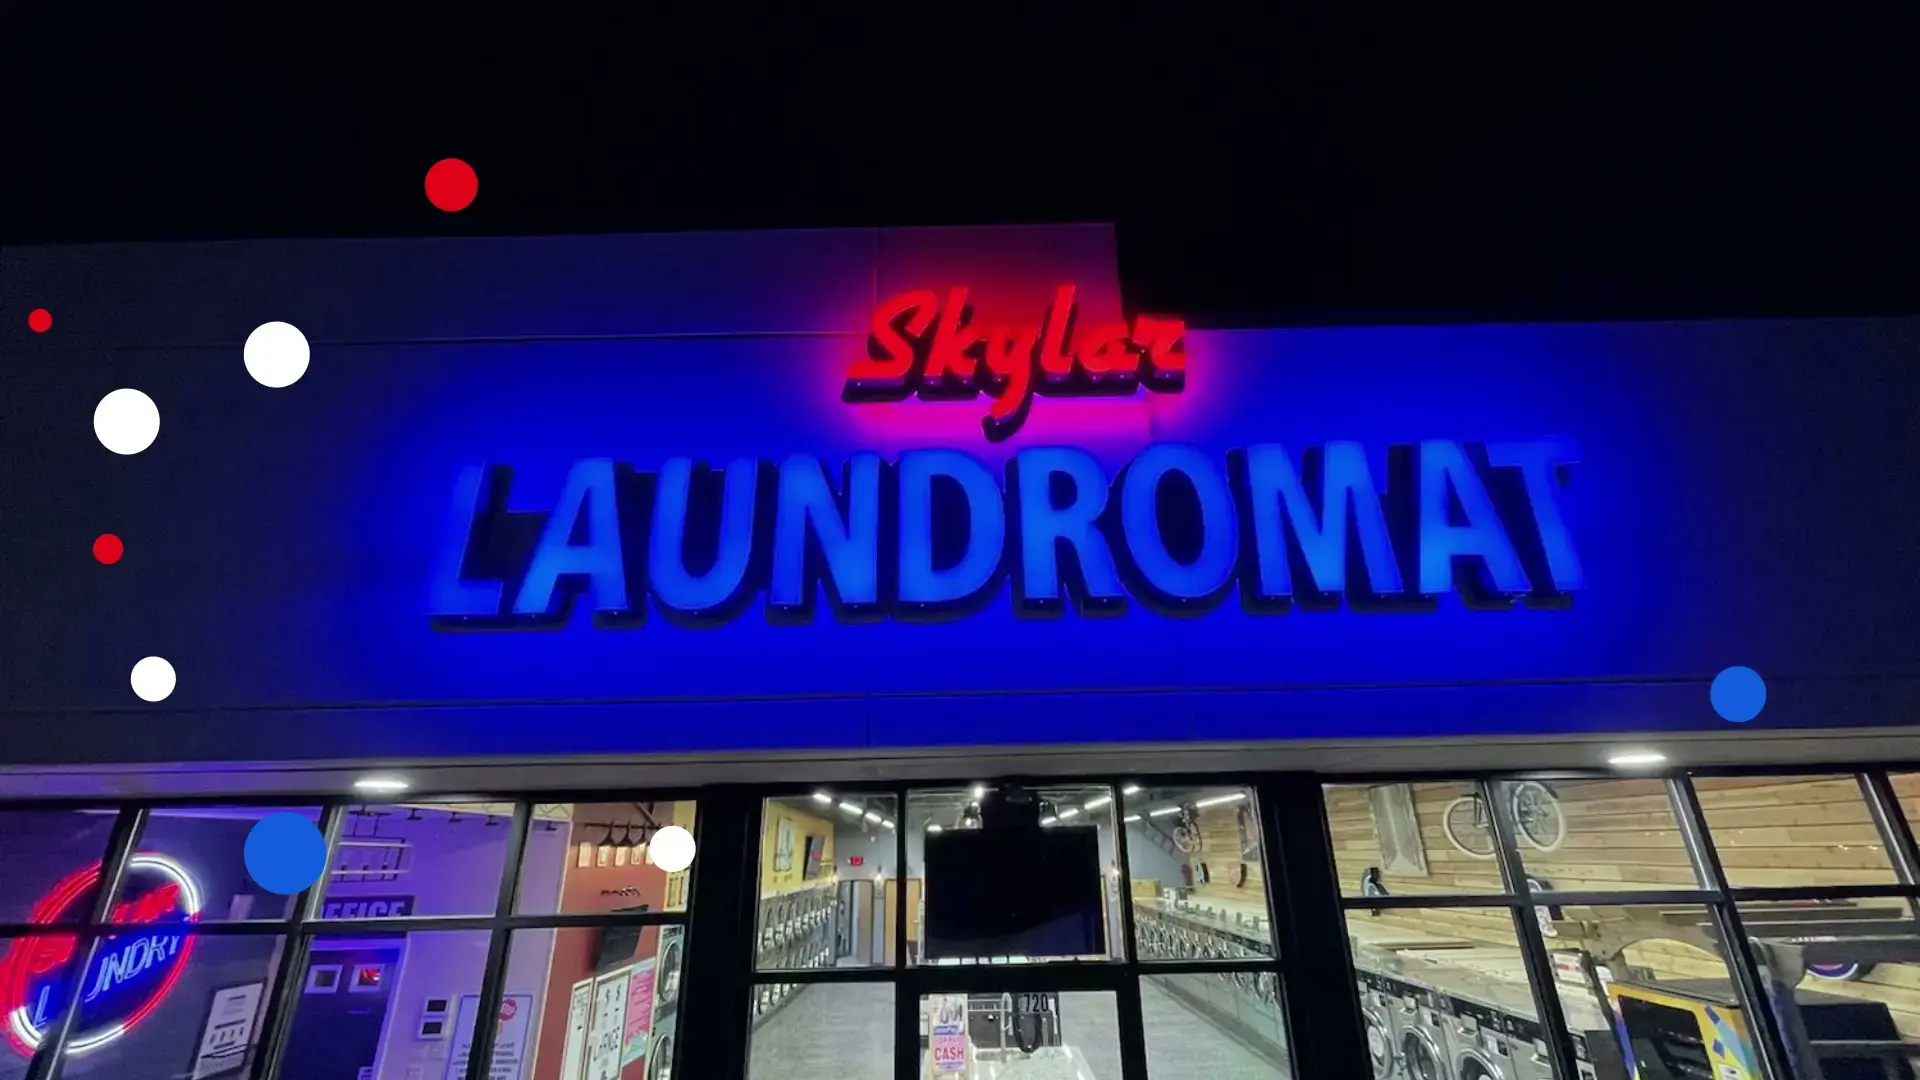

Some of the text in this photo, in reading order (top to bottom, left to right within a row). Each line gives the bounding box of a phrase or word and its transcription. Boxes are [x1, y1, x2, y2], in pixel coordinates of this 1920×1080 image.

[843, 285, 1186, 428] Skylar
[425, 436, 1586, 620] LAUNDROMAT
[321, 901, 405, 918] FFICE
[1023, 994, 1049, 1012] 720
[935, 1046, 964, 1060] CASH
